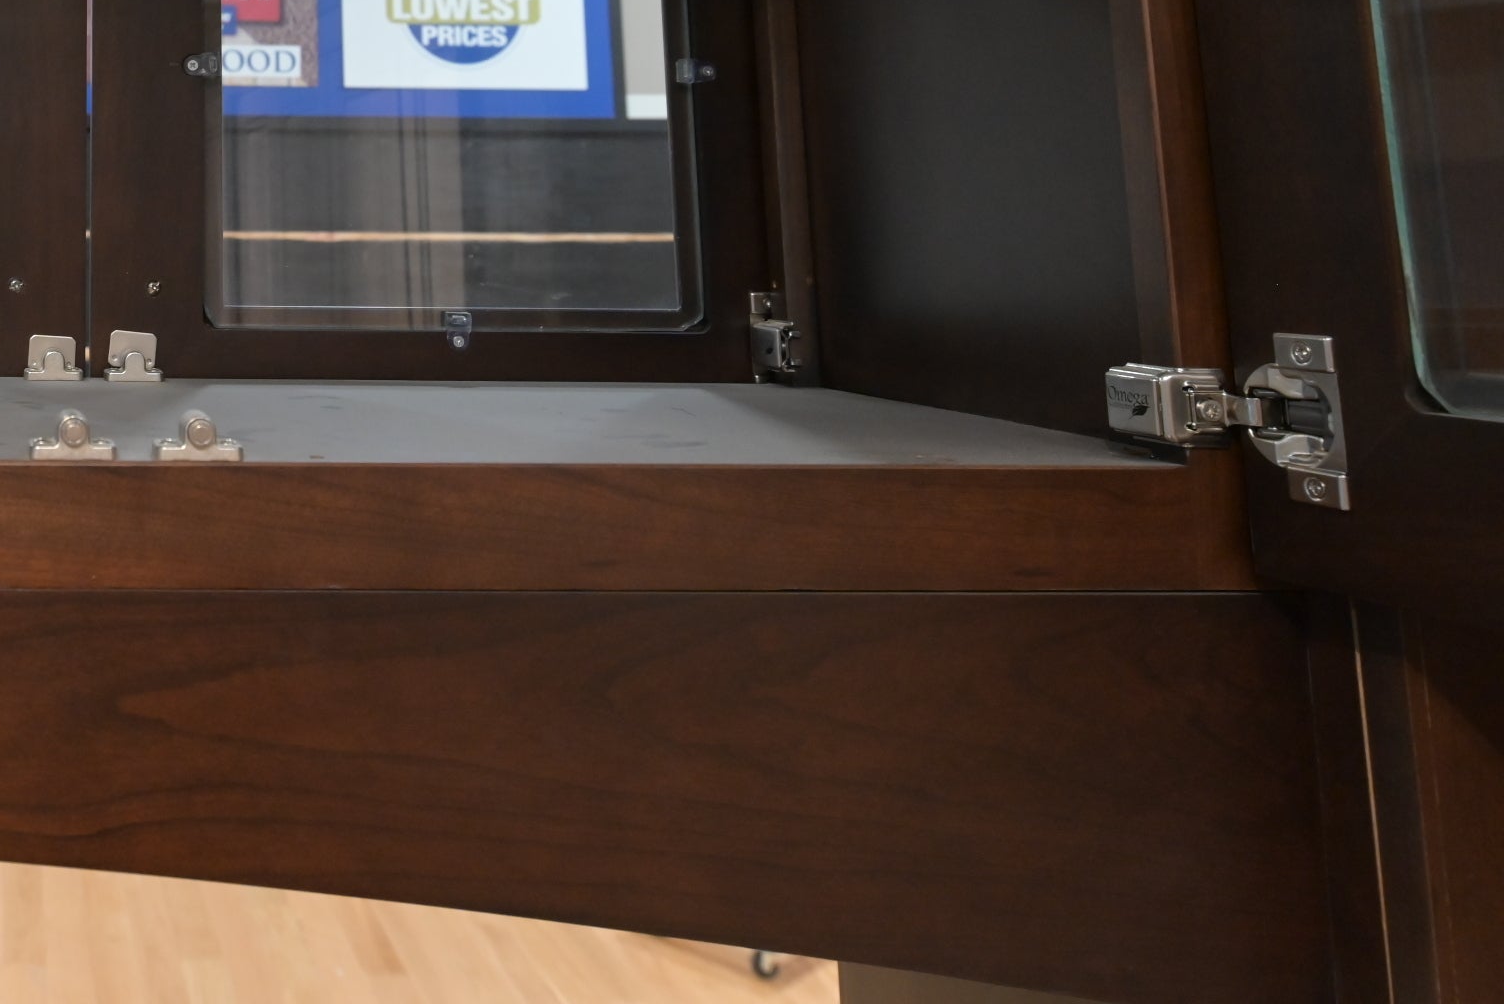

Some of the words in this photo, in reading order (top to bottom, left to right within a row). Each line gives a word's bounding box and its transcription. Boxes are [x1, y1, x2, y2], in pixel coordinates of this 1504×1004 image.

[421, 25, 509, 48] PRICES
[222, 49, 296, 74] OOD
[1107, 385, 1149, 406] Omega
